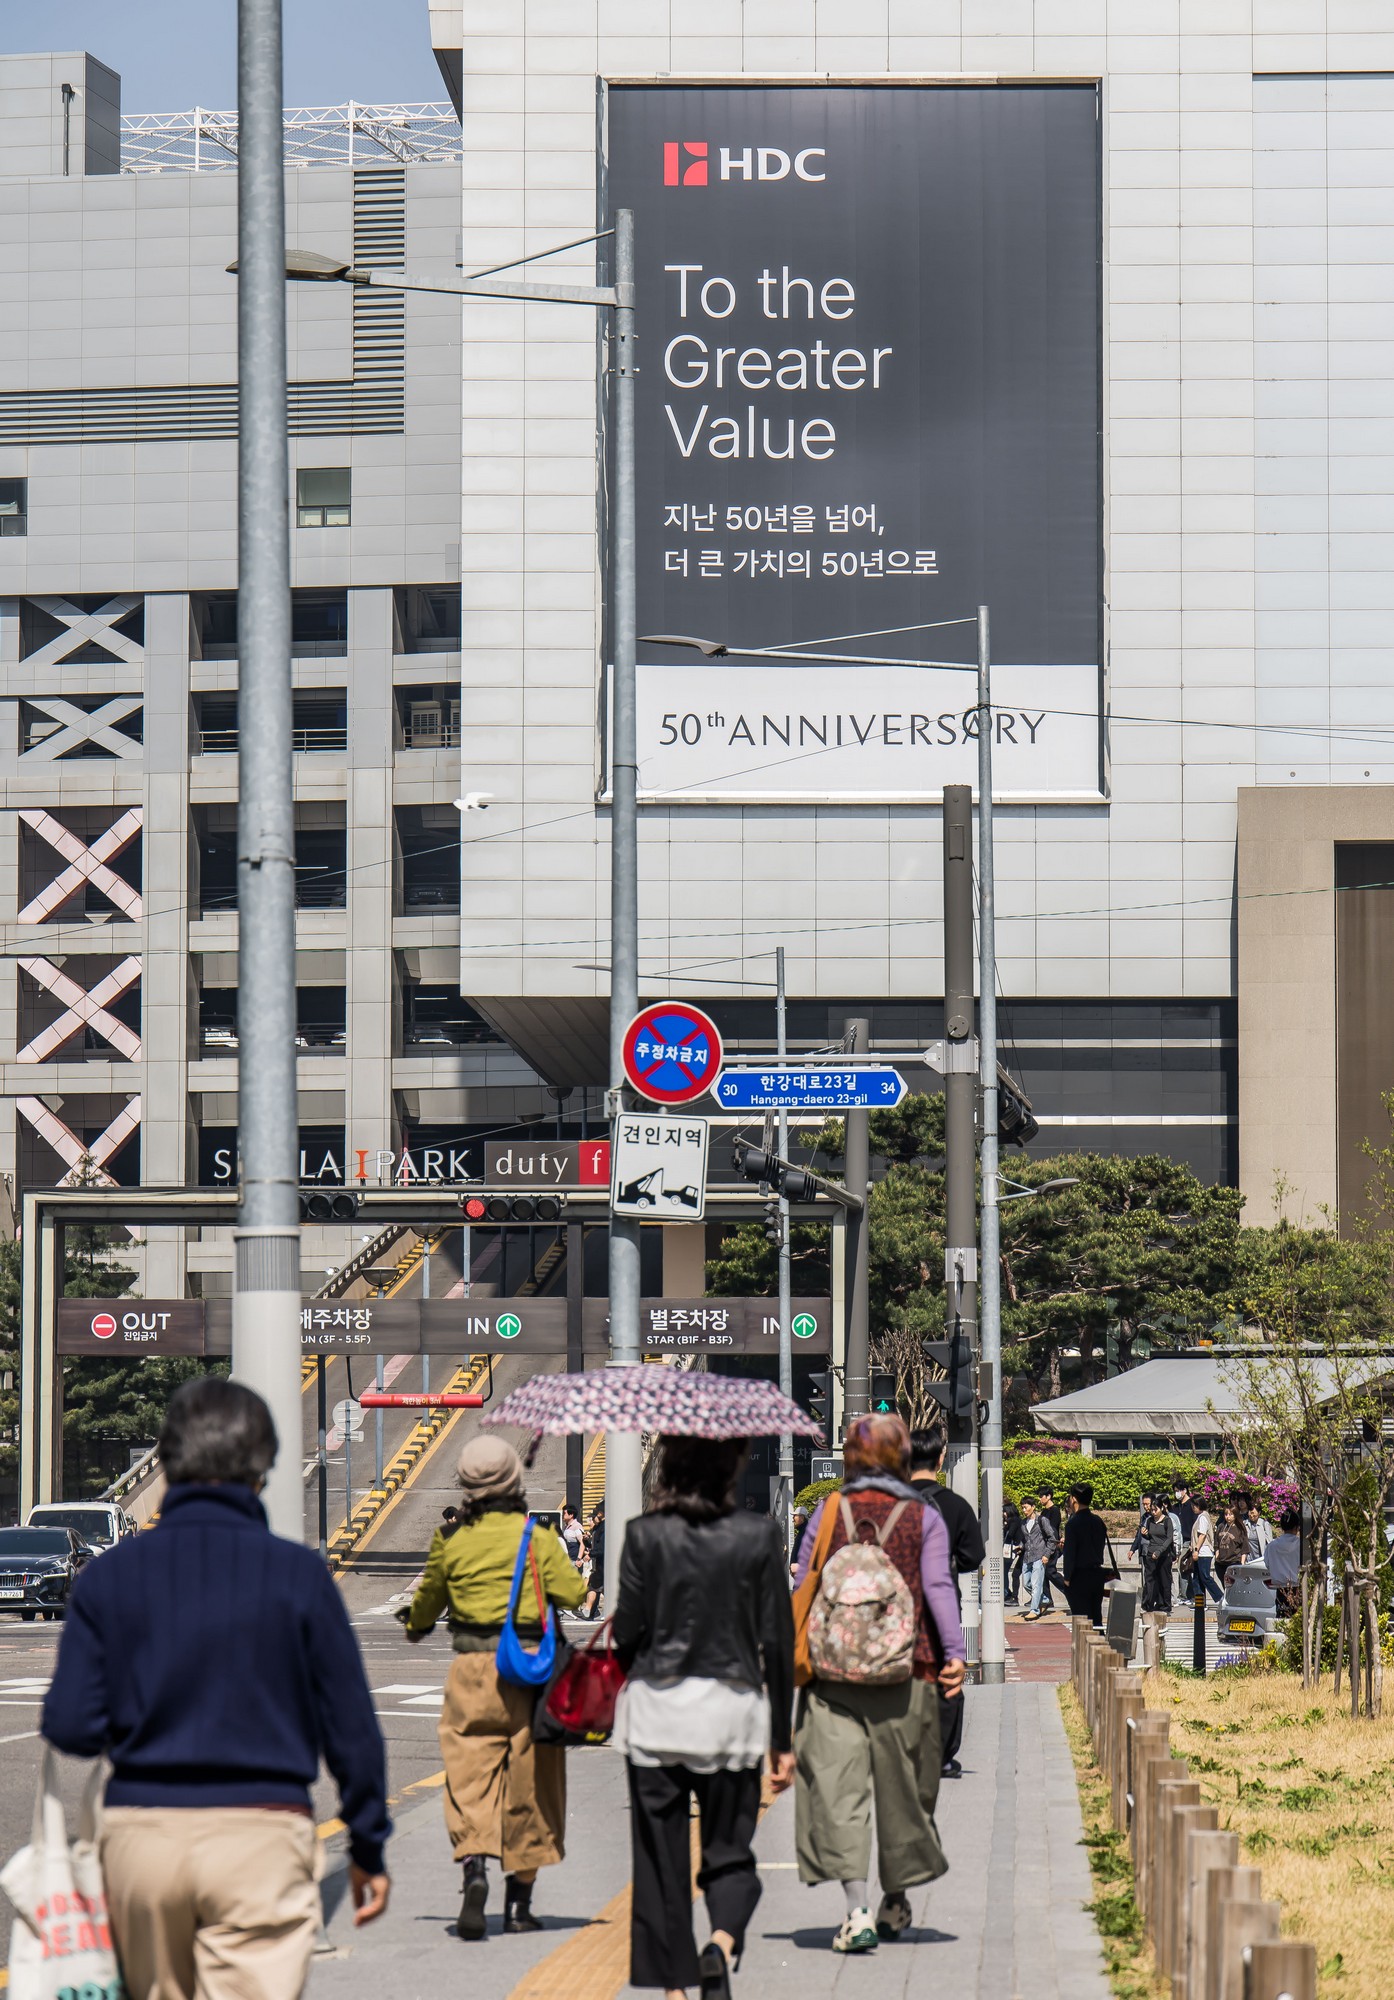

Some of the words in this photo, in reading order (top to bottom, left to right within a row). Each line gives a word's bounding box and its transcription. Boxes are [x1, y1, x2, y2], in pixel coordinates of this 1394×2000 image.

[719, 147, 826, 182] HDC
[664, 264, 736, 319] To
[757, 265, 855, 320] the
[664, 334, 893, 390] Greater
[664, 404, 836, 460] Value
[663, 503, 718, 533] 지난
[725, 504, 816, 533] 50년을
[825, 503, 885, 537] 넘어,
[664, 548, 688, 578] 더
[698, 550, 725, 577] 큰
[732, 549, 811, 579] 가치의
[821, 549, 939, 578] 50년으로
[659, 711, 725, 746] 50th
[728, 713, 1046, 746] ANNIVERSARY
[635, 1042, 708, 1065] 주정차금지
[722, 1083, 738, 1096] 30
[760, 1073, 857, 1092] 한강대로23길
[880, 1082, 896, 1095] 34
[750, 1094, 834, 1109] Hangang-daero
[836, 1094, 868, 1108] 23-gil
[623, 1124, 702, 1148] 견인지역
[495, 1149, 569, 1183] duty
[122, 1312, 172, 1331] OUT
[299, 1308, 373, 1330] 해주차장
[467, 1317, 490, 1335] IN
[650, 1308, 730, 1331] 별주차장
[123, 1331, 158, 1342] 진입금지
[301, 1335, 316, 1344] UN
[318, 1335, 336, 1345] (3F
[345, 1335, 371, 1345] 5.5F)
[646, 1335, 675, 1345] STAR
[677, 1335, 699, 1346] (B1F
[708, 1335, 733, 1346] B3F)
